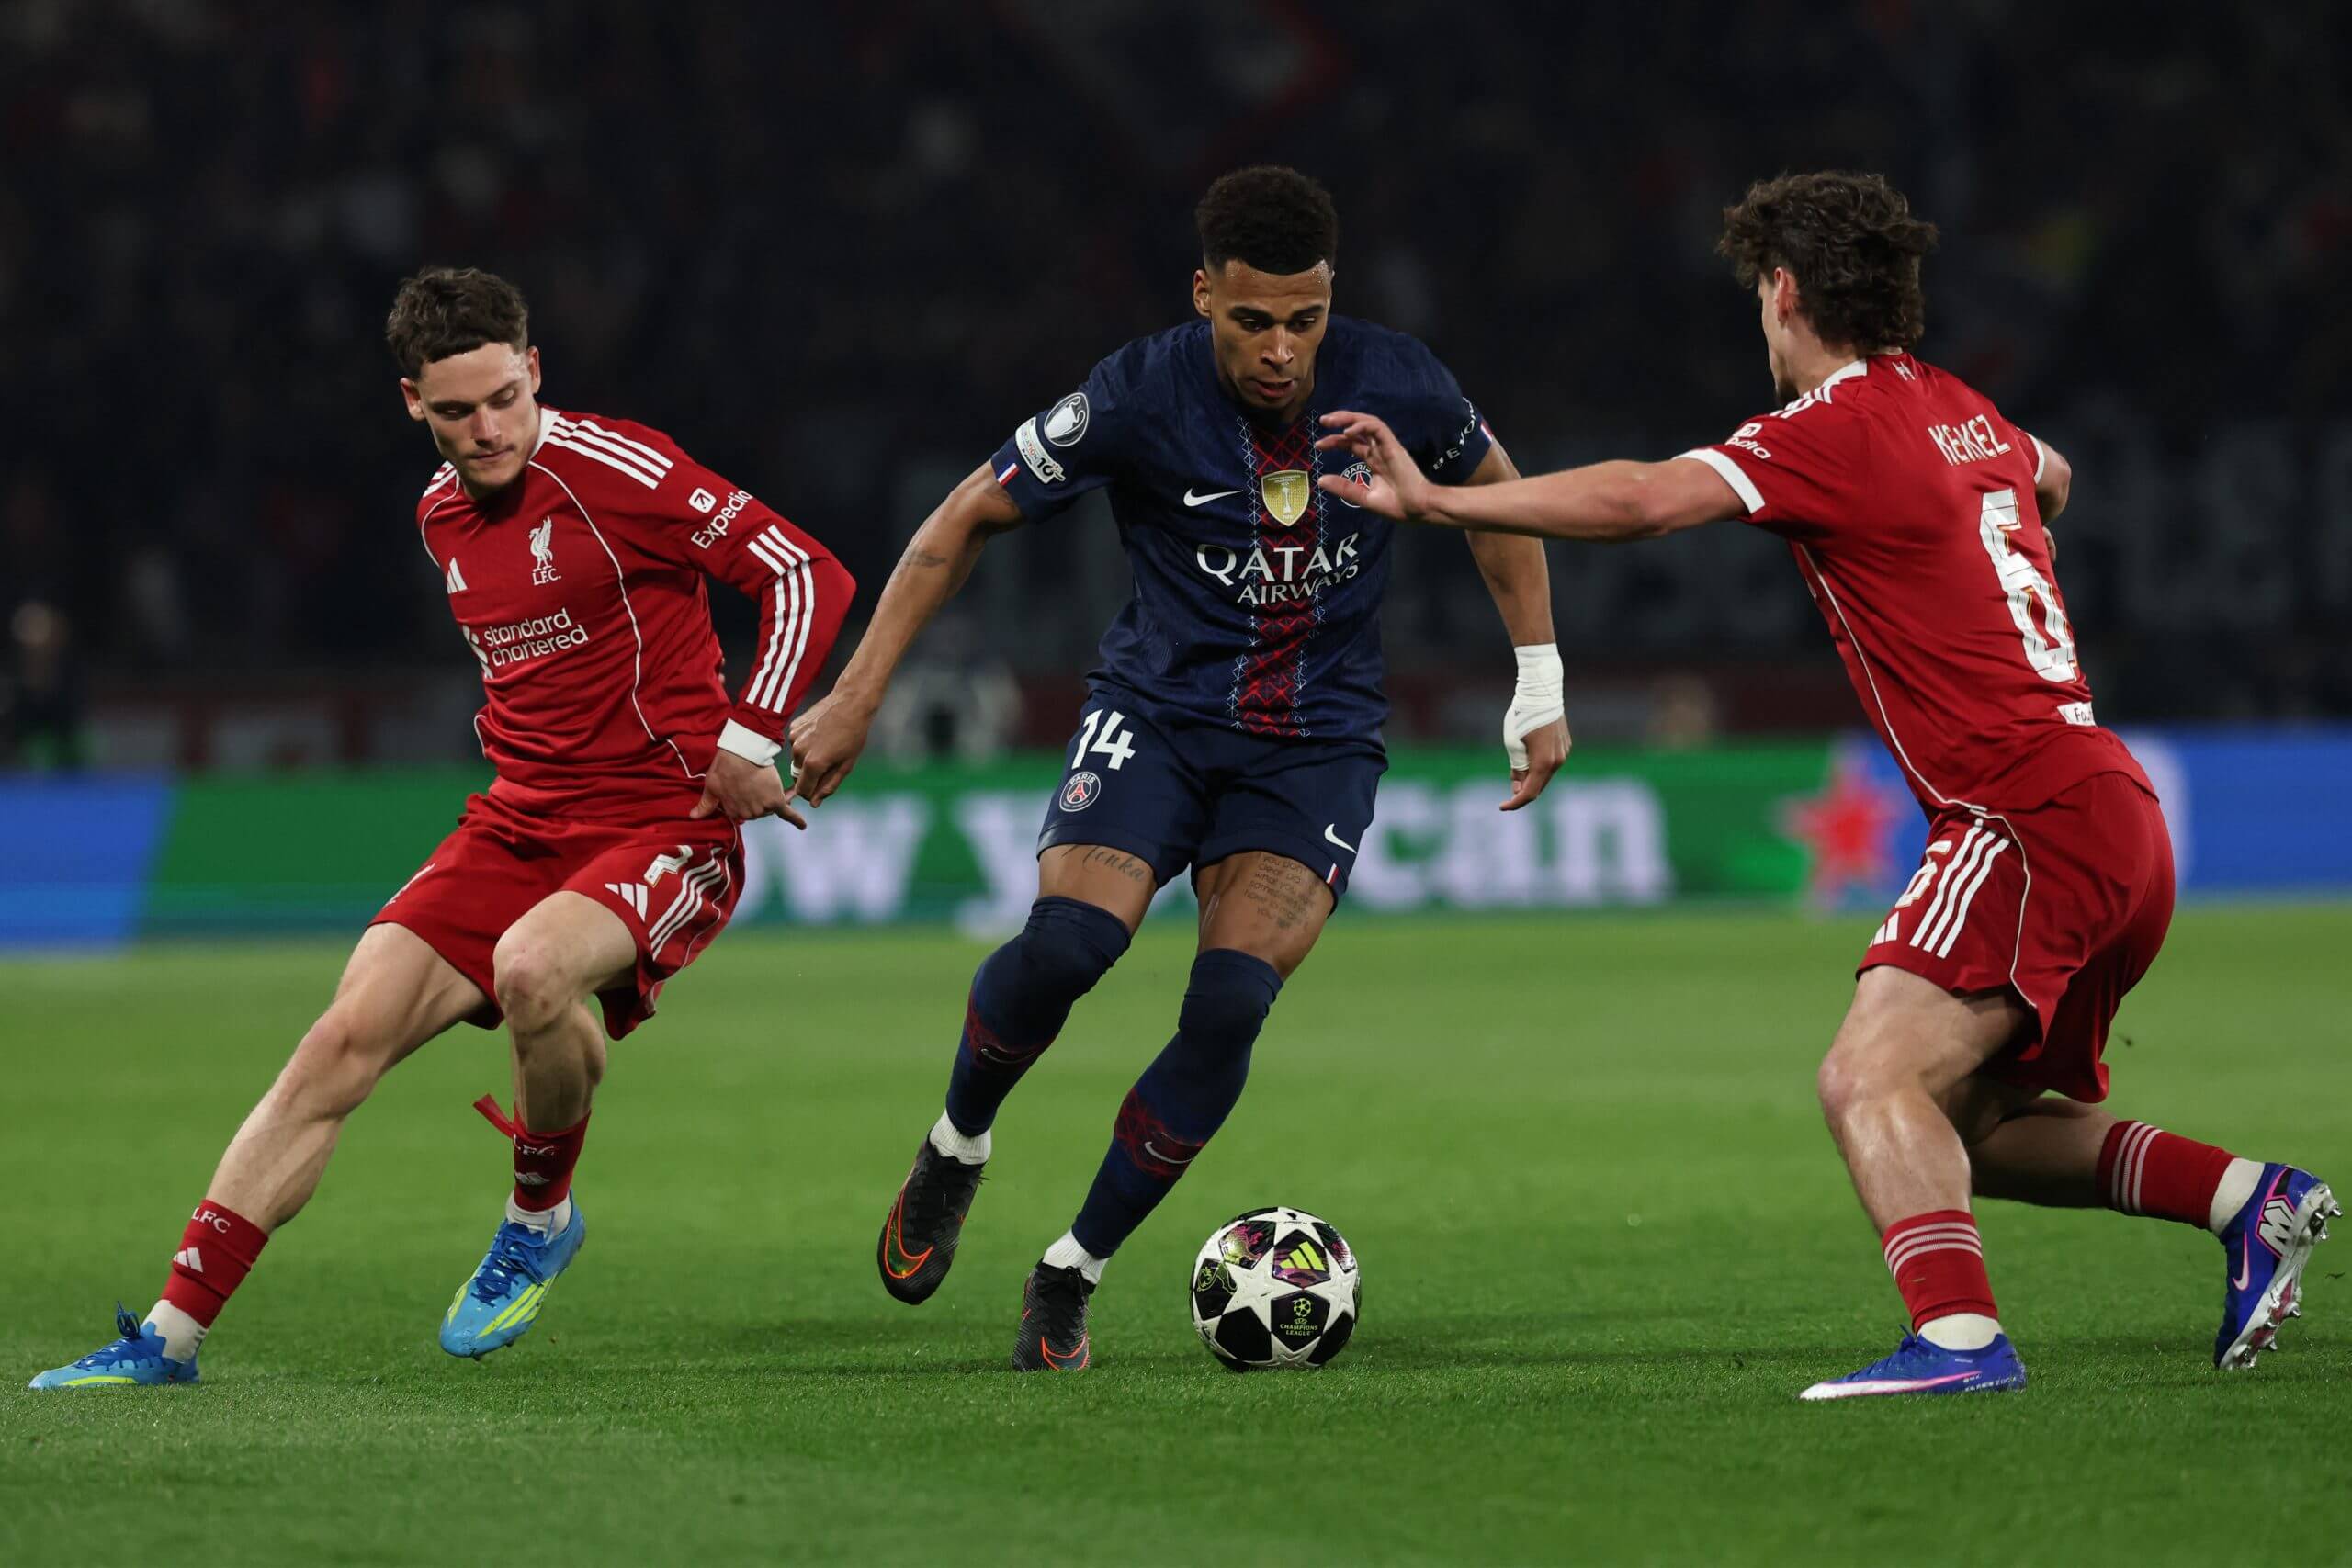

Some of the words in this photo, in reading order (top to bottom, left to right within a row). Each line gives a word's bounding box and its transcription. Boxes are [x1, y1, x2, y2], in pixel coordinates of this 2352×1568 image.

[691, 490, 753, 549] Expedia
[1196, 532, 1360, 586] QATAR
[1237, 558, 1361, 604] AIRWAYS
[1979, 488, 2078, 683] 6
[483, 607, 571, 646] standard
[492, 625, 588, 667] chartered
[1071, 708, 1136, 771] 14
[1069, 773, 1096, 786] PARIS
[1341, 779, 1672, 909] can
[191, 1206, 231, 1234] LFC
[1279, 1323, 1319, 1332] CHAMPIONS
